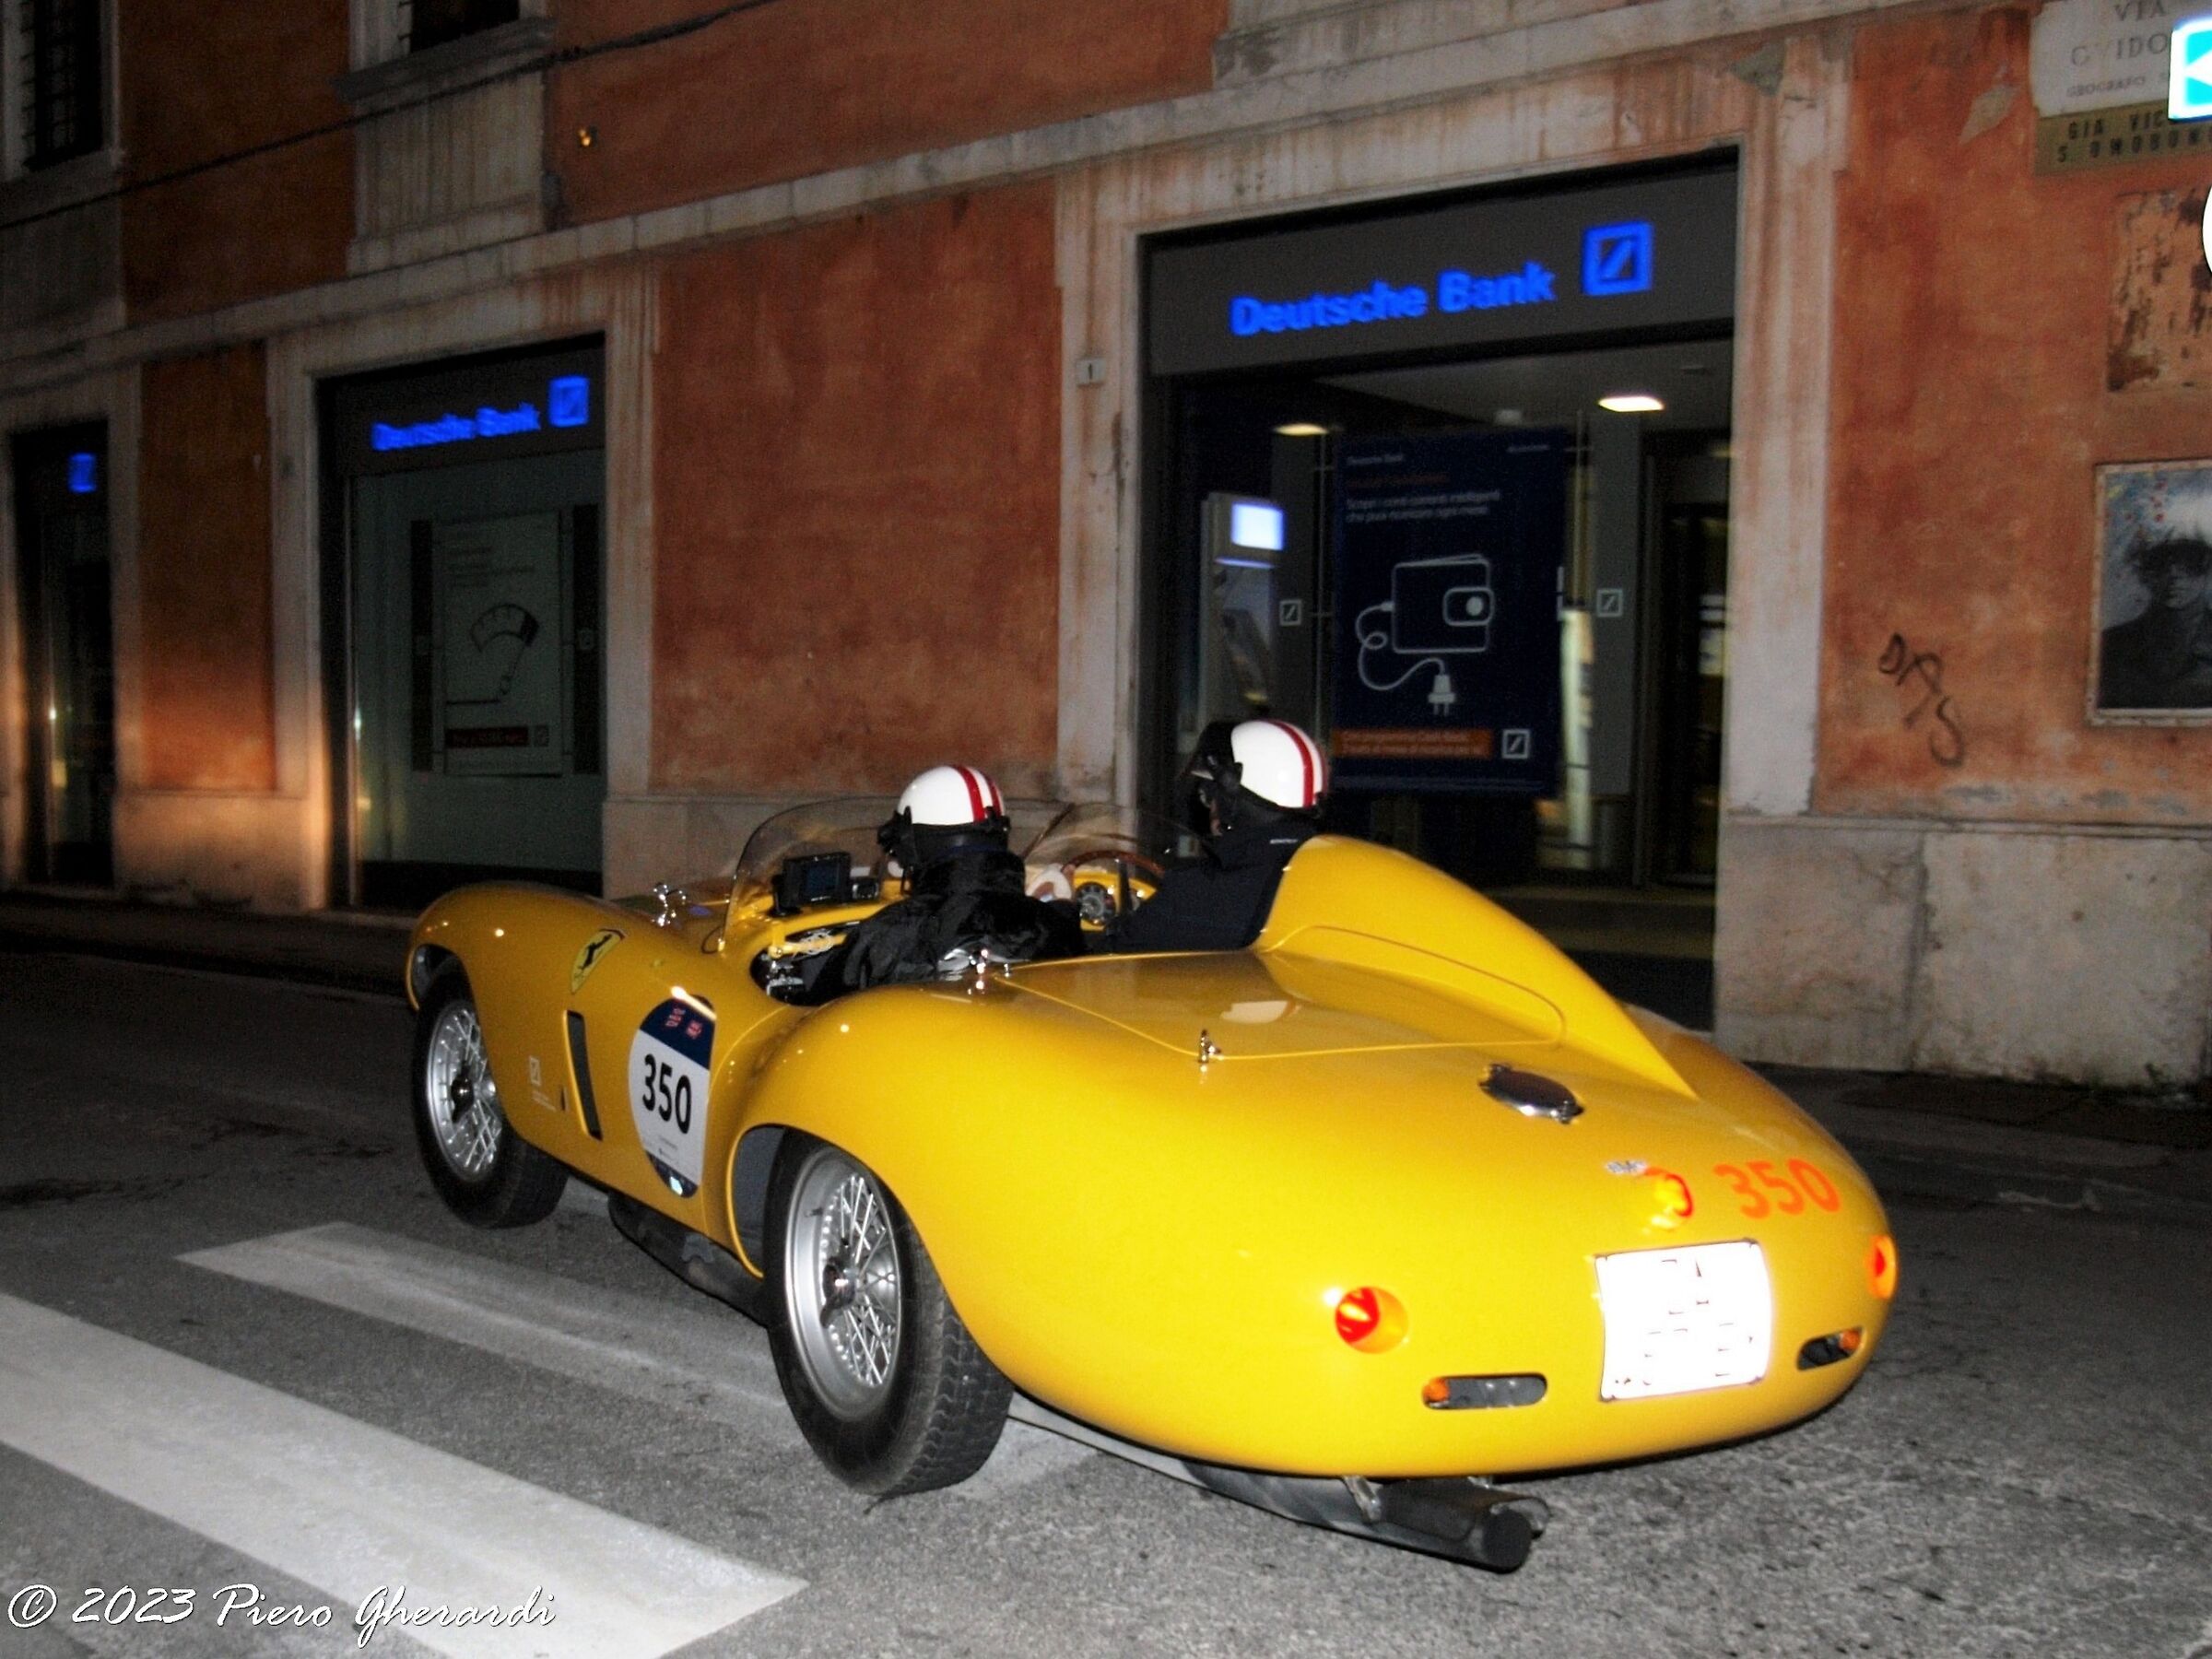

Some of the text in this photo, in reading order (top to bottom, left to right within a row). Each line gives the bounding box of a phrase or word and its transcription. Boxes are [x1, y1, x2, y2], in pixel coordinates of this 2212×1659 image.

[2114, 0, 2168, 21] VIA
[2071, 33, 2168, 66] GIDO
[1230, 259, 1556, 337] Deutsche Bank
[642, 1053, 691, 1135] 350
[1712, 1158, 1841, 1219] 350
